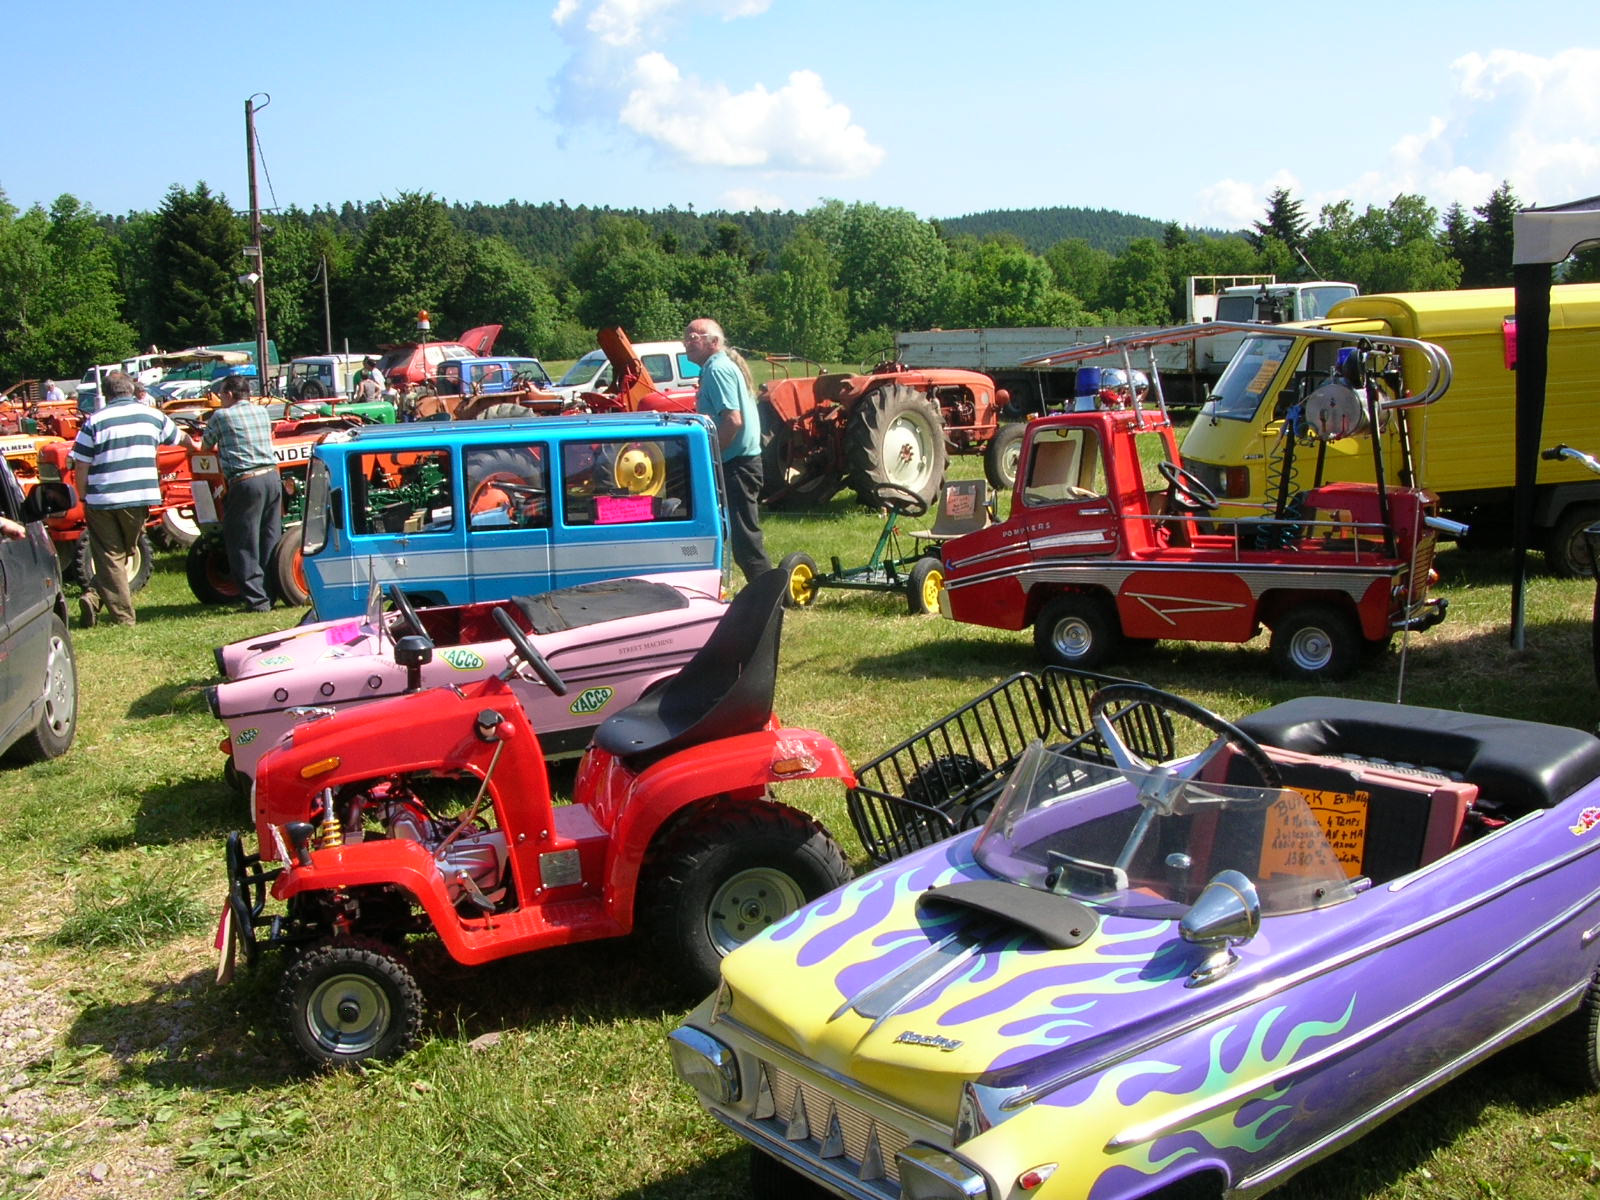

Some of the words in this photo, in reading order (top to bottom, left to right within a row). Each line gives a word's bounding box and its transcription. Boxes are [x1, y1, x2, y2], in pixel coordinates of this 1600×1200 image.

[0, 443, 33, 451] ALMERS
[273, 446, 310, 461] NDE
[1002, 522, 1052, 538] POMPIERS
[618, 643, 643, 655] STREET
[643, 638, 674, 650] MACHINE
[573, 690, 609, 712] YACCO
[894, 1030, 964, 1052] Racing
